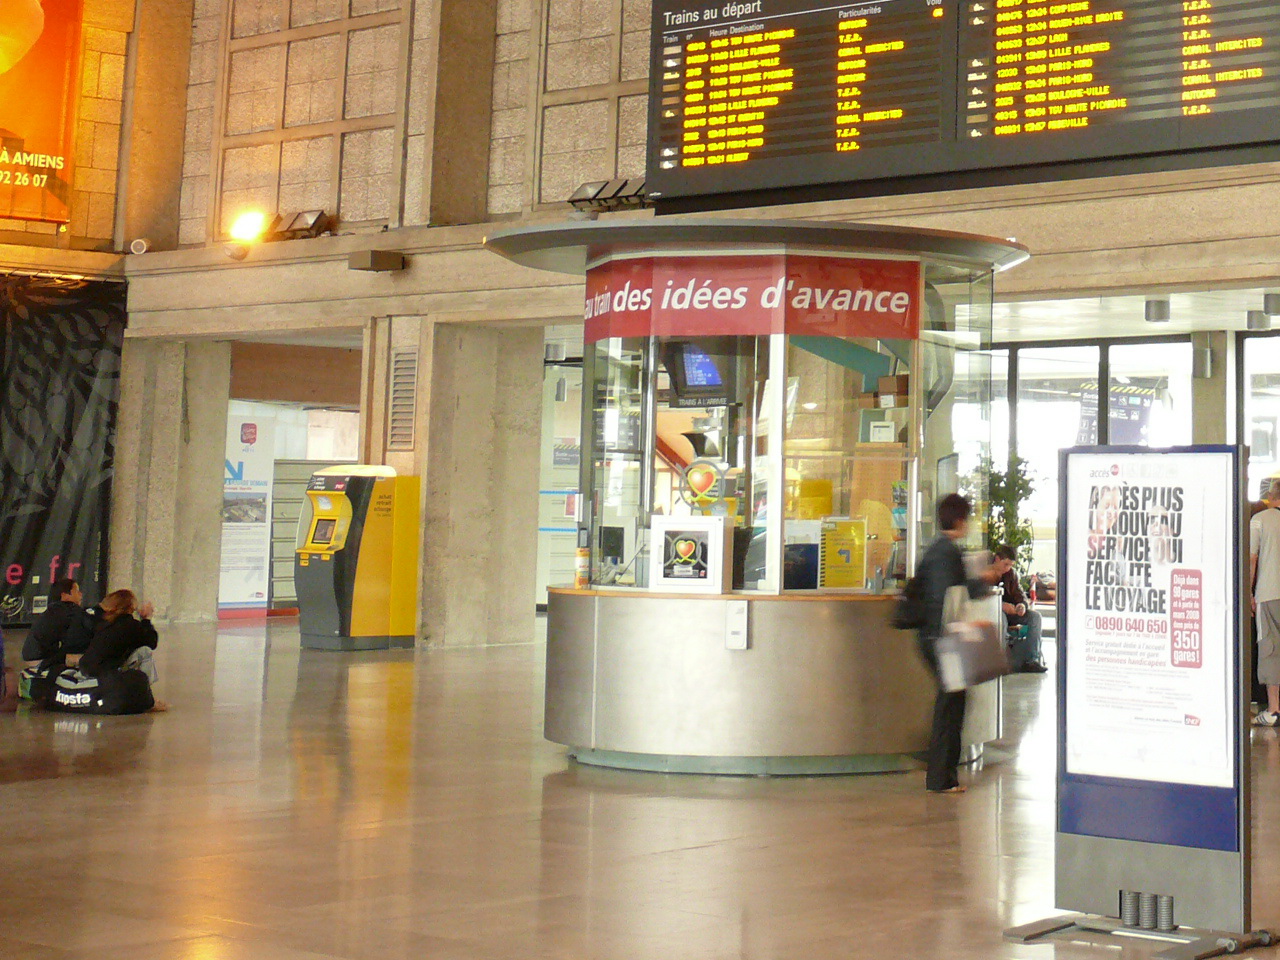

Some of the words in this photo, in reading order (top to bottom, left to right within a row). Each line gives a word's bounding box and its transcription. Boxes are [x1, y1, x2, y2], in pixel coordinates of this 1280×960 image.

[663, 10, 700, 26] Trains
[703, 8, 718, 20] au
[722, 0, 762, 18] départ
[838, 6, 882, 19] Particularités
[709, 28, 728, 38] Heure
[1049, 46, 1072, 58] LILLE
[12, 151, 64, 170] AMIENS
[14, 172, 29, 186] 26
[33, 174, 48, 188] 07
[613, 280, 653, 312] des
[660, 278, 748, 310] idées
[760, 276, 910, 313] d'avance
[1142, 486, 1184, 512] PLUS
[1105, 511, 1182, 538] NOUVEAU
[1087, 535, 1151, 562] SERVICE
[1152, 538, 1183, 566] QUI
[1085, 585, 1101, 610] LE
[1103, 586, 1166, 614] VOYAGE
[1095, 616, 1123, 631] 0890
[1125, 617, 1145, 633] 640
[1147, 618, 1167, 634] 650
[1173, 630, 1200, 650] 350
